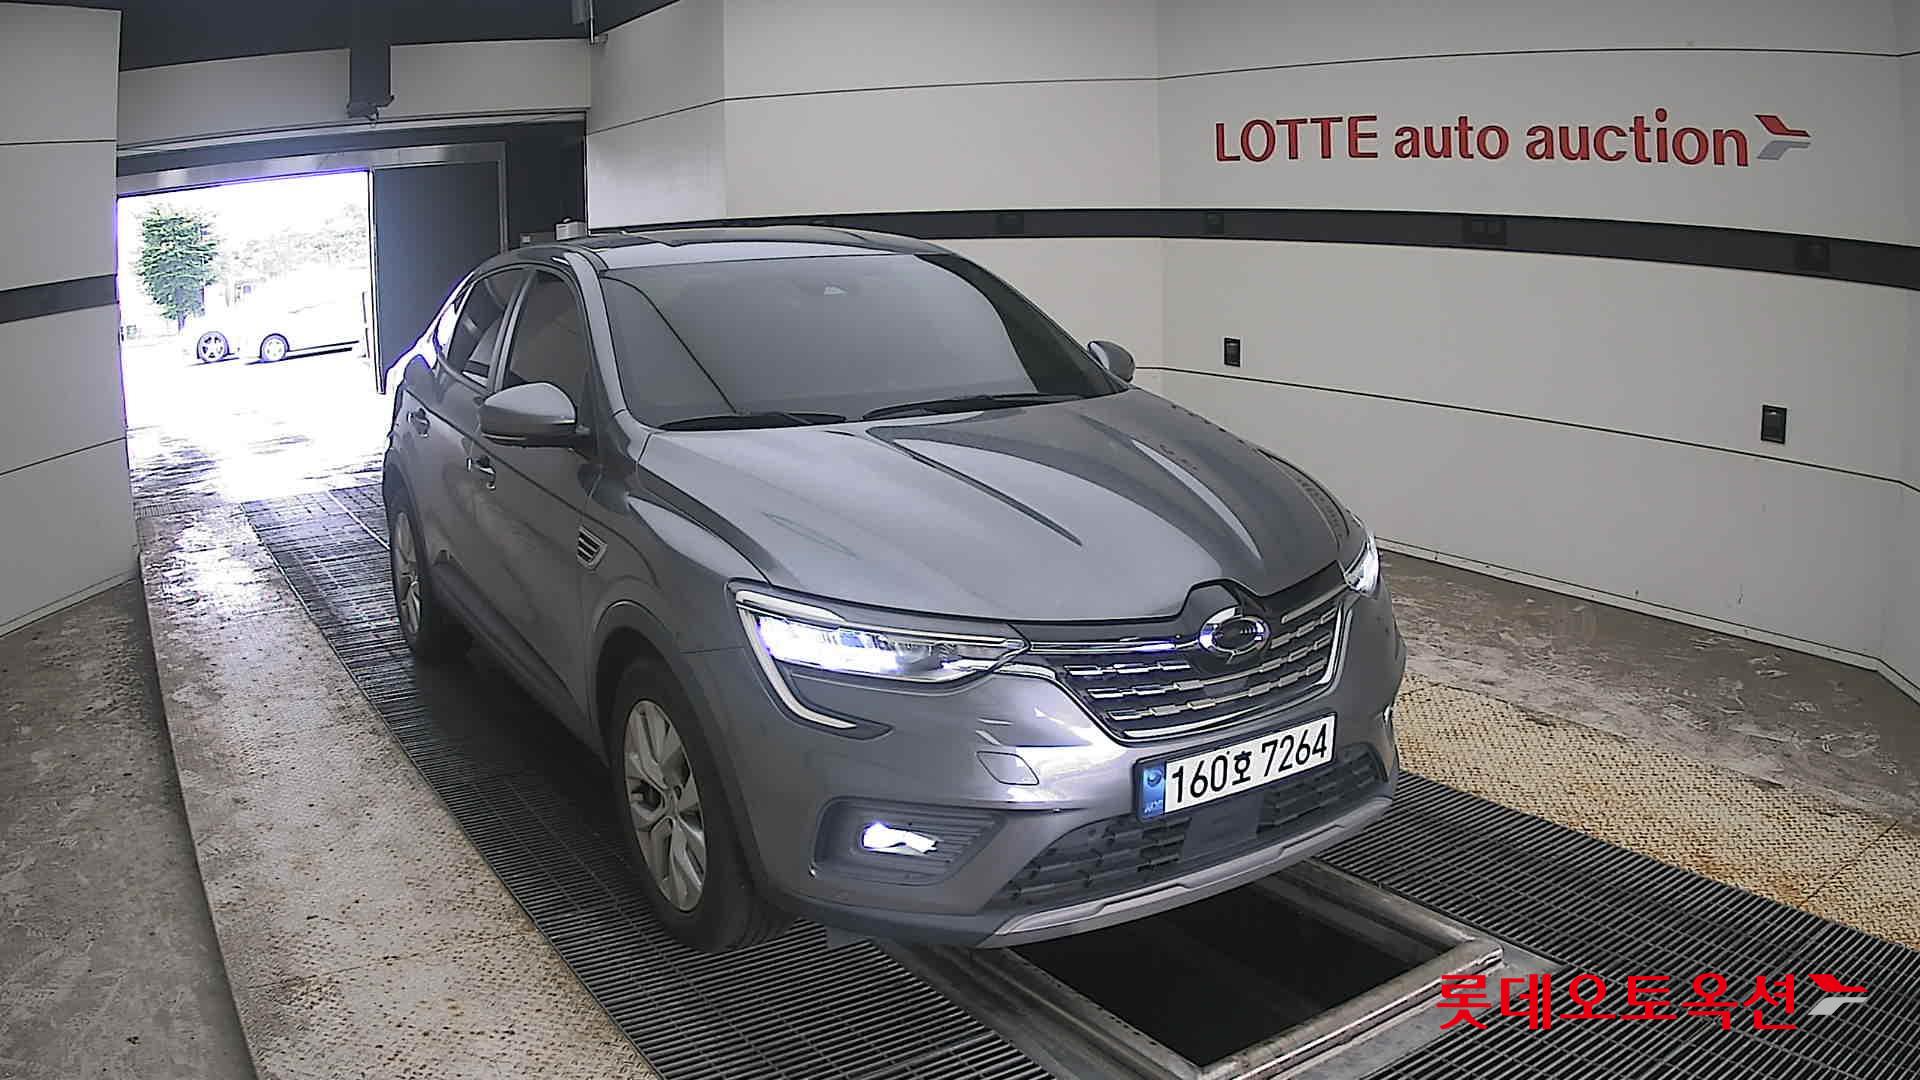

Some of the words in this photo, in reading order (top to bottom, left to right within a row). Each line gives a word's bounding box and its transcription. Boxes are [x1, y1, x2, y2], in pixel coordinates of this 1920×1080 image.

[1215, 114, 1379, 163] LOTTE
[1394, 115, 1510, 161] auto
[1525, 108, 1750, 168] auction
[1172, 750, 1252, 803] 160호
[1261, 723, 1328, 777] 7264
